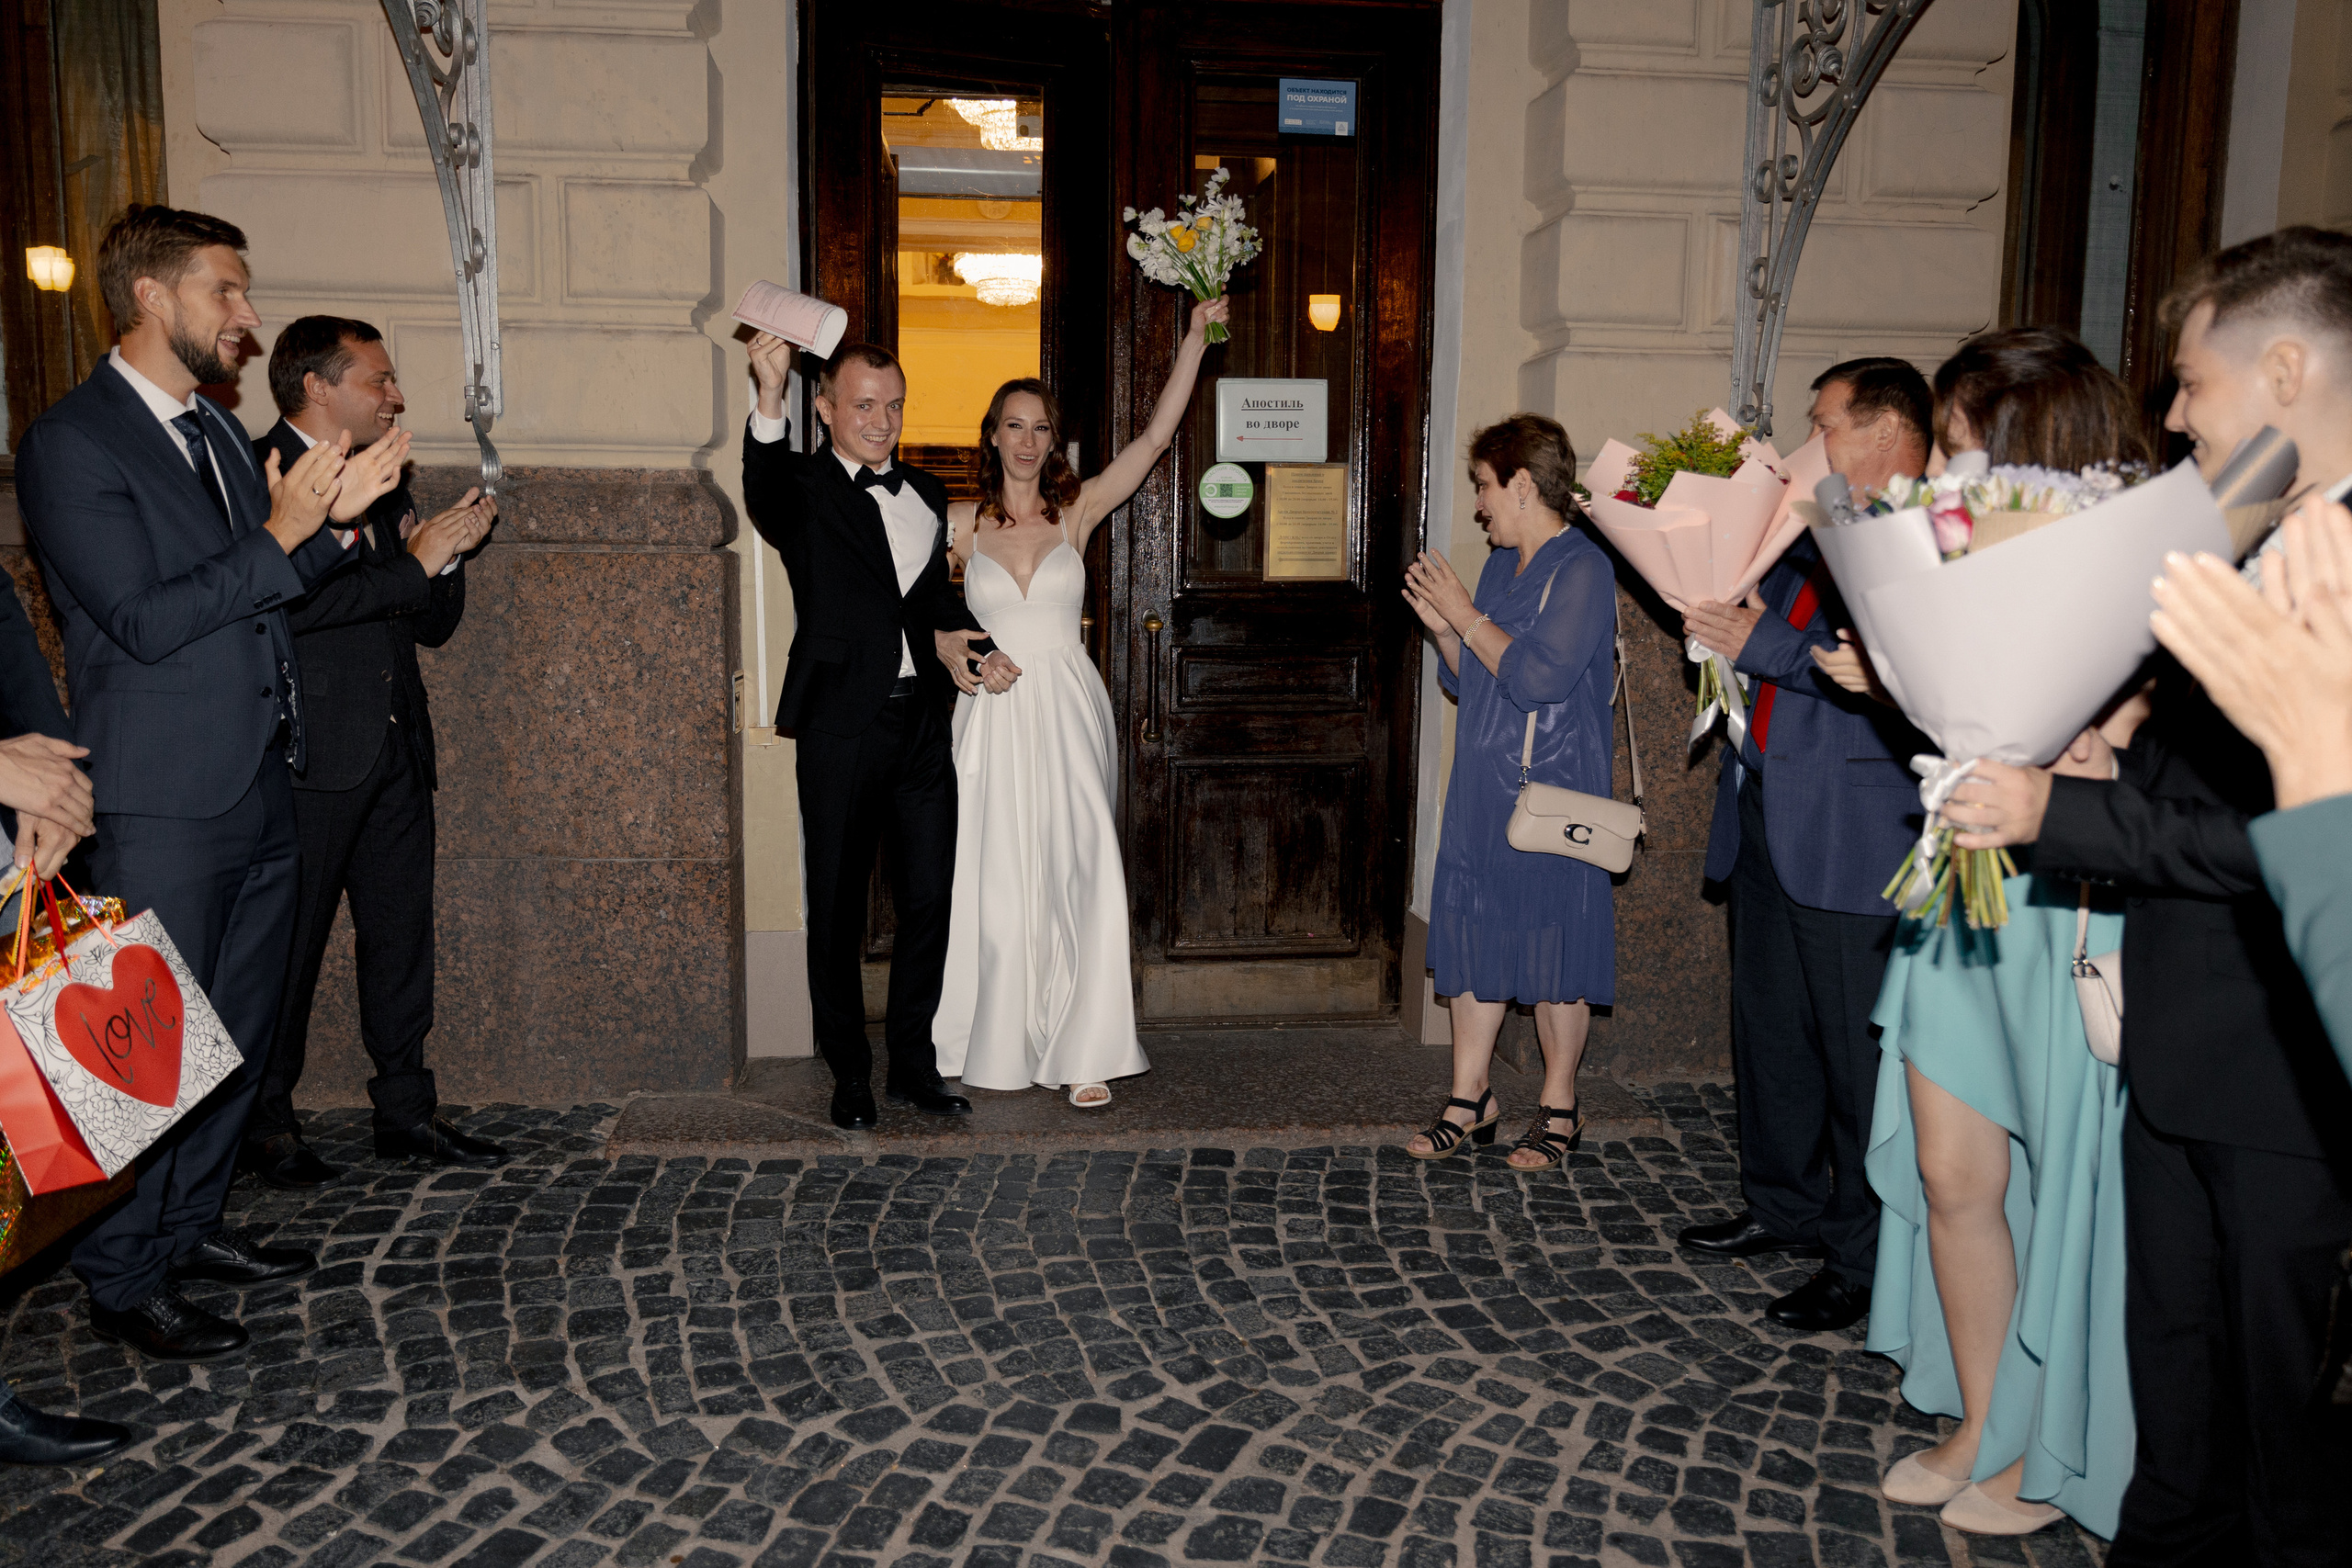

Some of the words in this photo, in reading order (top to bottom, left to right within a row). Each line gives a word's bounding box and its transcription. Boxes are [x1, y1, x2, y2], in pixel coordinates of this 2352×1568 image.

[1286, 95, 1306, 103] ПОД
[1306, 95, 1347, 104] ОХРАНОЙ
[1241, 398, 1304, 409] Апостиль
[1246, 420, 1261, 429] во
[1263, 420, 1300, 432] дворе
[1564, 823, 1593, 846] C
